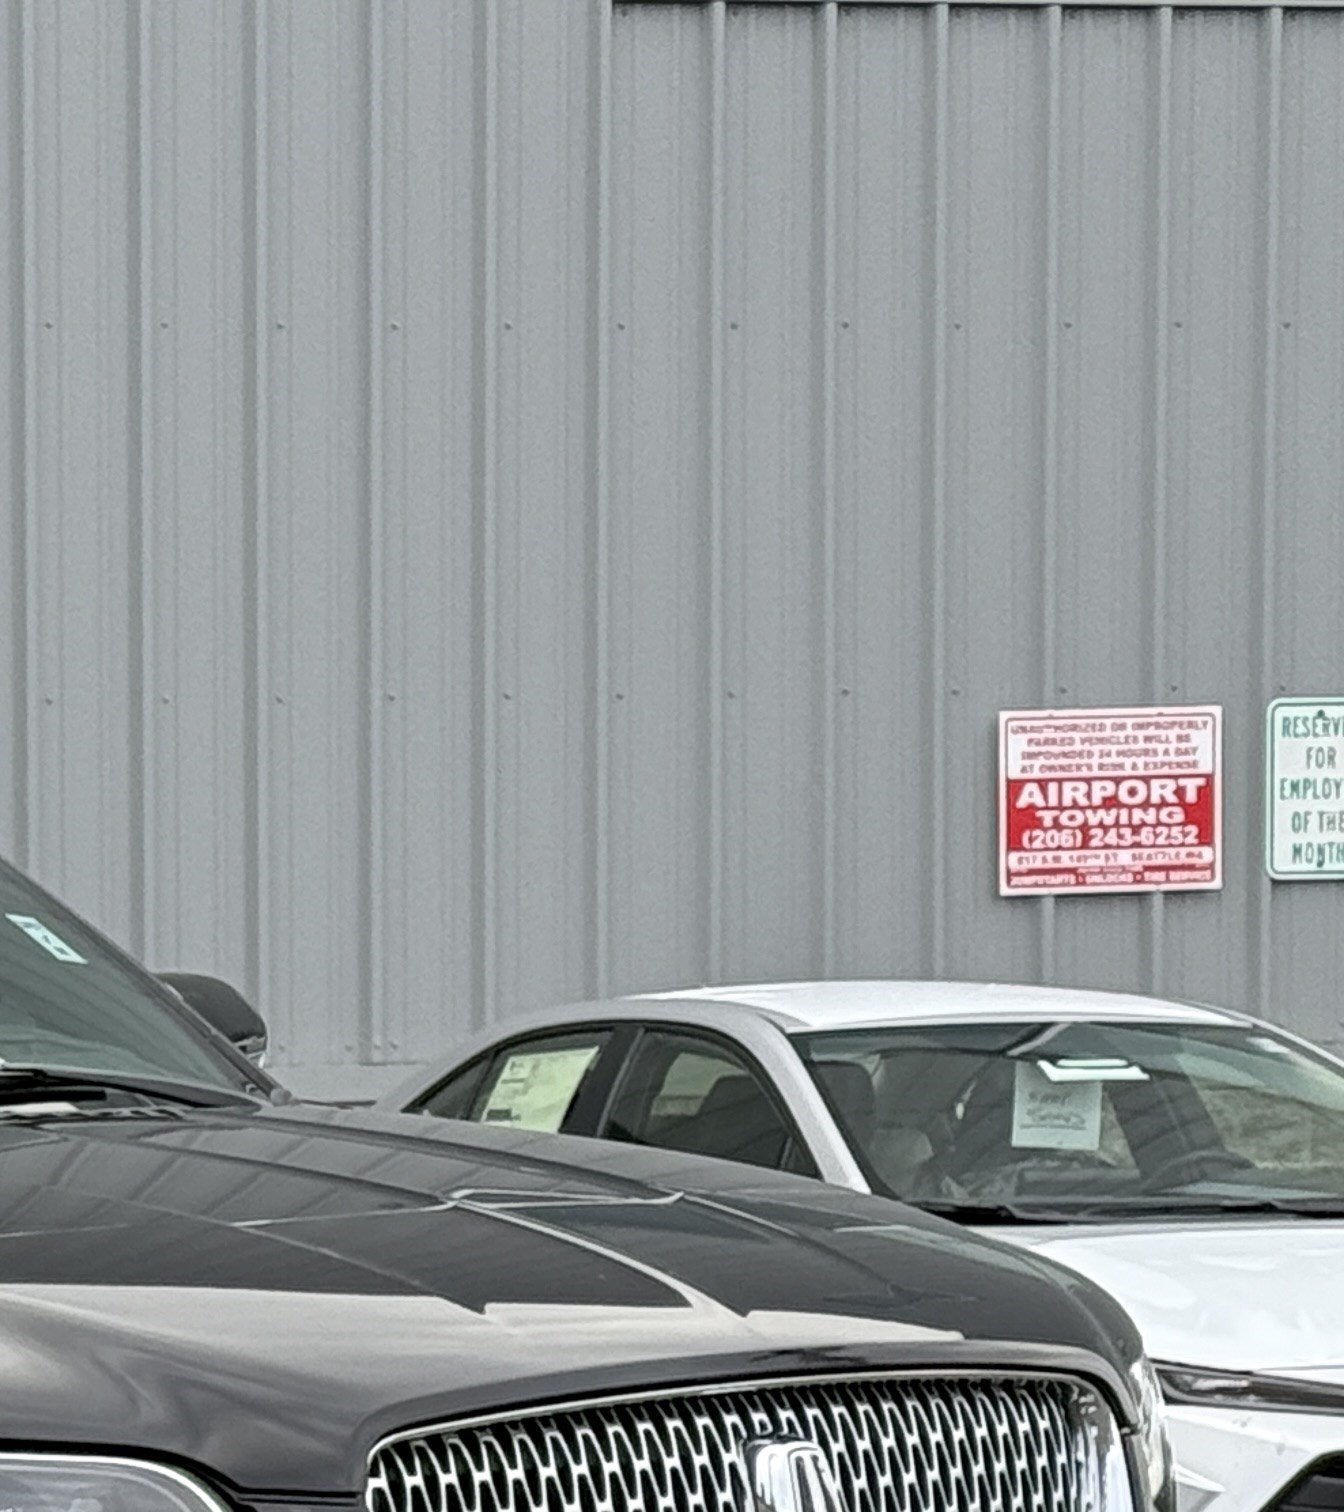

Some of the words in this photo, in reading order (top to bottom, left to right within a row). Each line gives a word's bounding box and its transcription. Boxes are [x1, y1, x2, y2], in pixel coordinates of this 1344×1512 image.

[1143, 734, 1172, 745] WILL
[1162, 747, 1171, 758] A
[1306, 746, 1337, 769] FOR
[1015, 777, 1207, 809] AIRPORT
[1035, 806, 1185, 828] TOWING
[1291, 811, 1312, 833] OF
[1316, 810, 1344, 833] THE
[1022, 828, 1083, 849] (206)
[1088, 825, 1199, 847] 243-6252
[1292, 841, 1344, 866] MONTH
